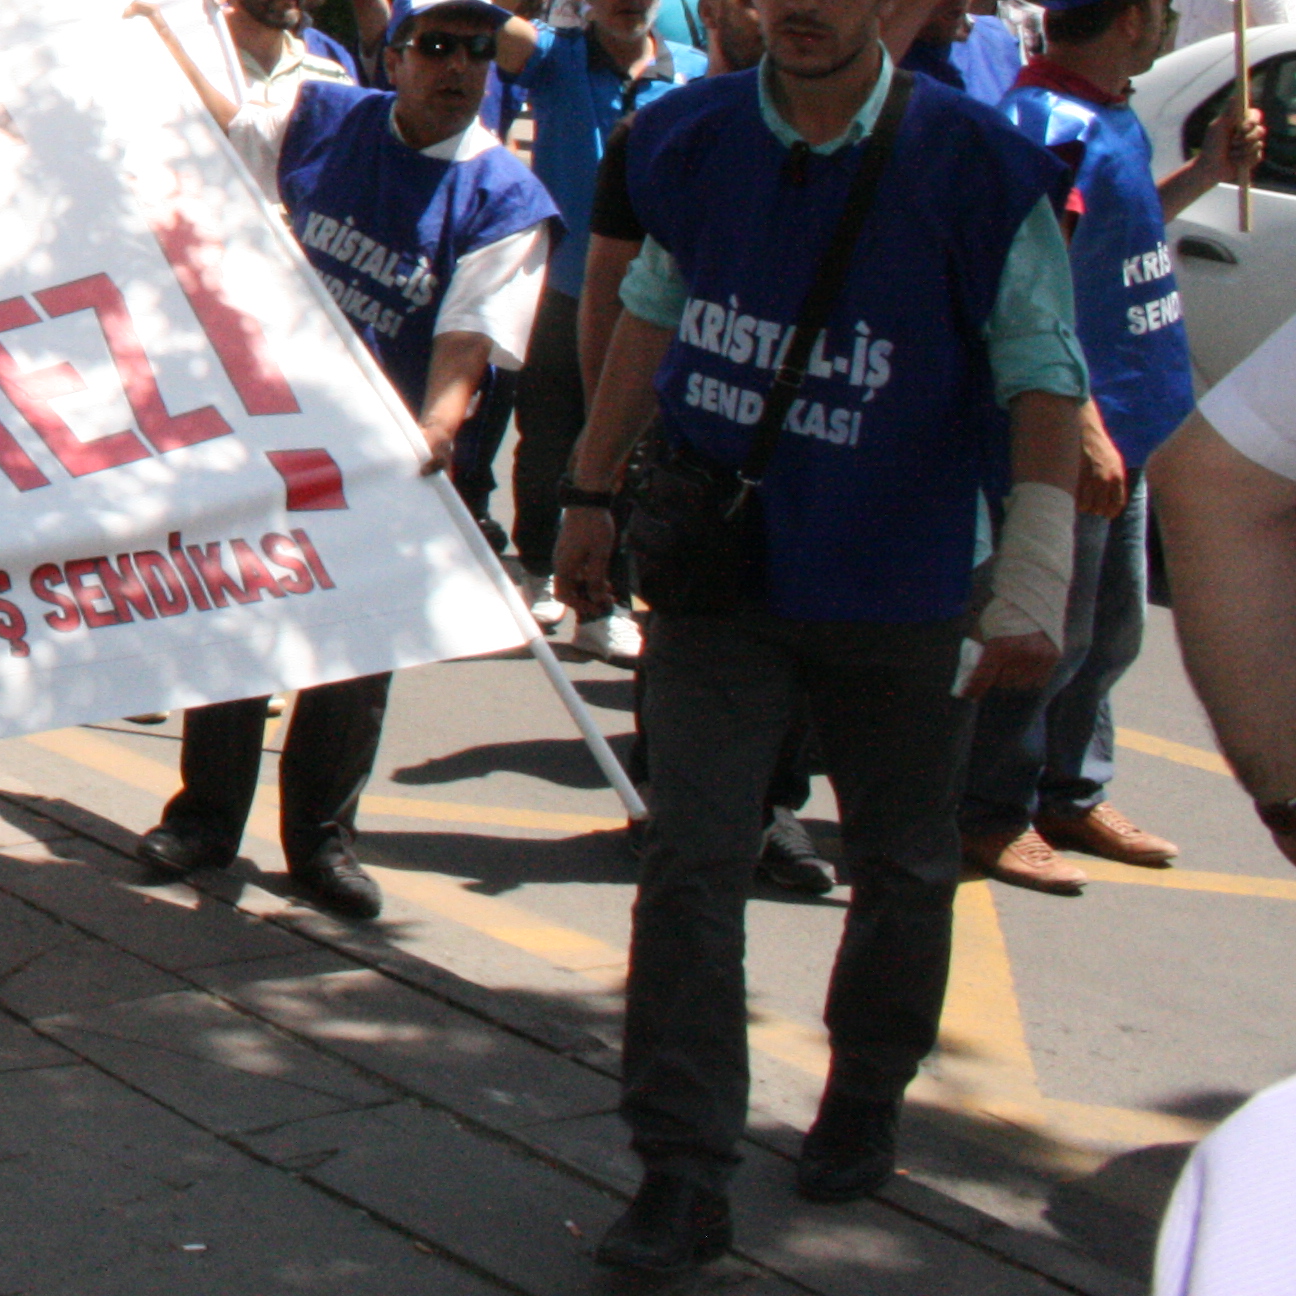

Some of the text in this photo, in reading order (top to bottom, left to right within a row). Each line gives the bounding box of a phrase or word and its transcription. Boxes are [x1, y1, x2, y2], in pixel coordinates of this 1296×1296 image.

[302, 210, 439, 314] KRİSTAL-İŞ
[685, 371, 863, 446] SENDKASI
[28, 528, 338, 633] SENDİKASI
